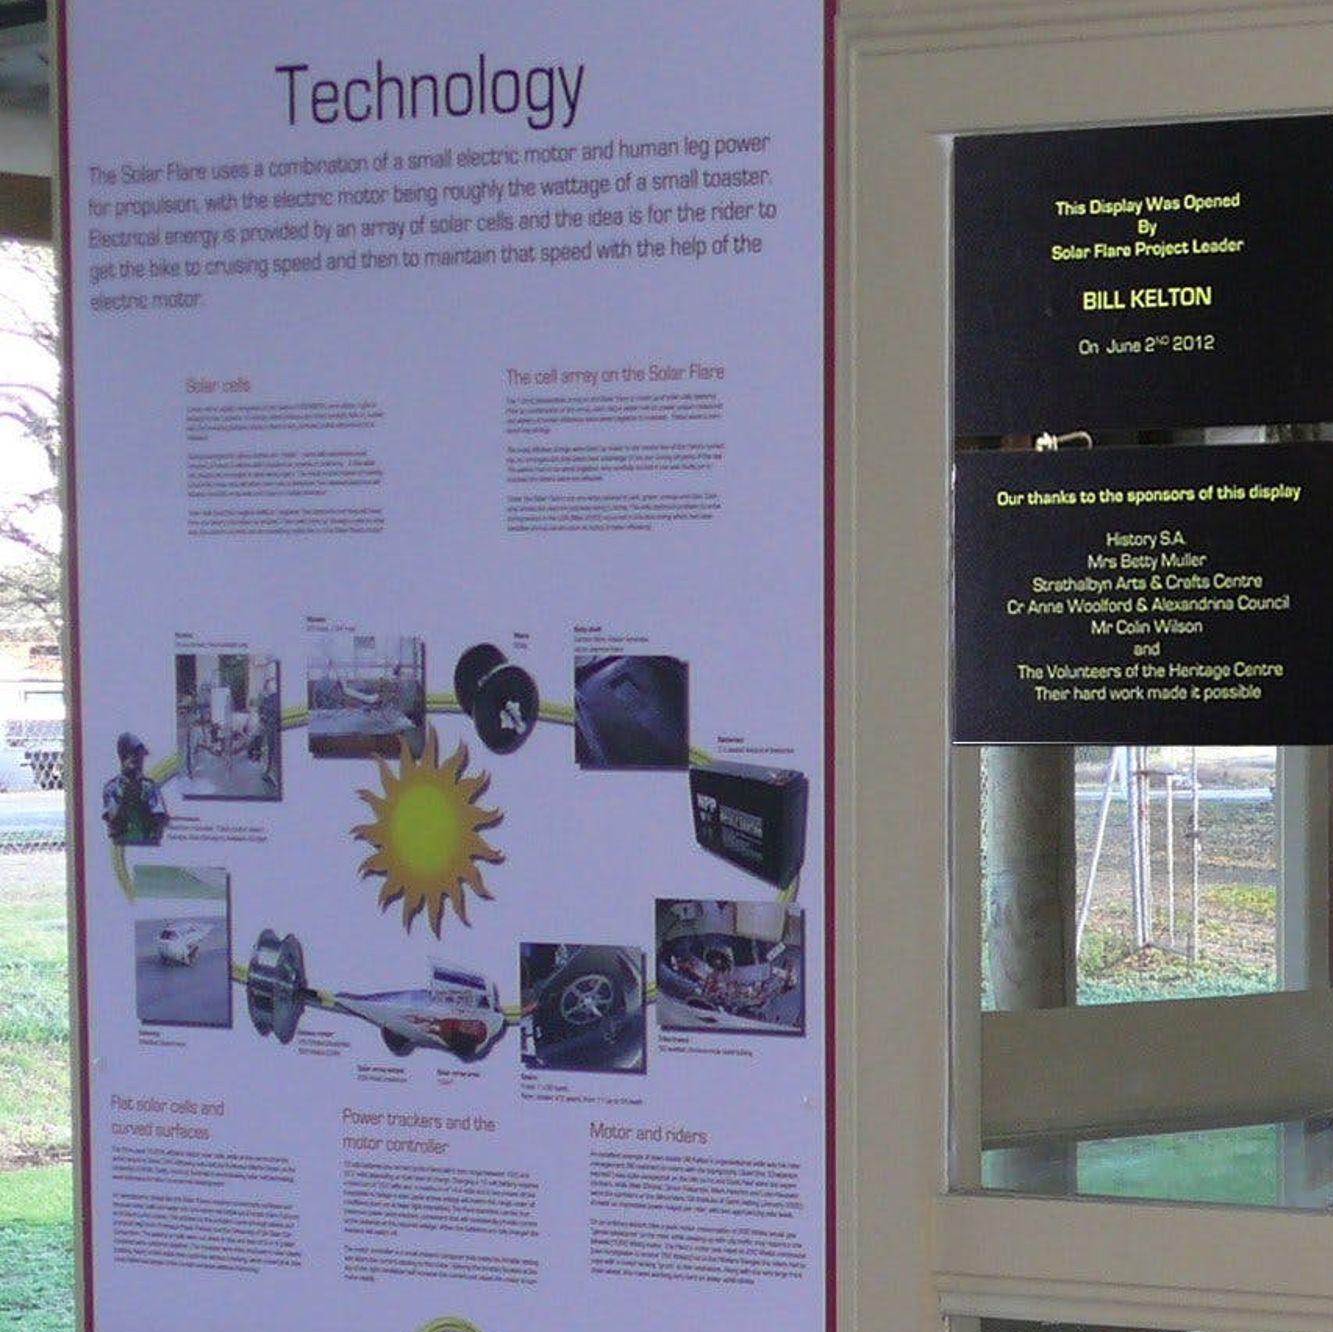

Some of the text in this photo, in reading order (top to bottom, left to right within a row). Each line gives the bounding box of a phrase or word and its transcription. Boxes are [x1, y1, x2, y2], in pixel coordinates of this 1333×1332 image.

[275, 53, 586, 131] Technology
[90, 135, 770, 185] The Solar Flare uses combination of small electric motor and human leg power
[338, 168, 699, 207] motor being roughly the wattage of small
[1055, 191, 1241, 217] This Display Was Opened
[240, 200, 777, 245] provided array of solar cells and the idea for the rider to
[1138, 218, 1158, 237] By
[272, 233, 762, 278] speed and then to maintain that speed with the help of the
[1051, 237, 1245, 261] Solar Flare Project Leader
[1083, 285, 1213, 311] BILL KELTON
[1078, 338, 1100, 355] On
[1106, 338, 1142, 354] June
[1172, 333, 1216, 352] 2012
[506, 362, 726, 387] The cell array on the Solar Flare
[996, 483, 1302, 507] Our thanks to the sponsors of this display
[1106, 531, 1157, 549] History
[1088, 552, 1207, 572] Mrs Betty Muller
[1032, 572, 1263, 596] Strathalbyn Arts & Crafts Centre
[1007, 594, 1290, 615] Cr Anne Woolford & Alexandrina Council
[1091, 617, 1203, 635] Mr Colin Wilson
[1132, 641, 1161, 657] and
[1016, 661, 1284, 682] The Volunteers of the Heritage Centre
[1034, 685, 1071, 701] Their
[1073, 685, 1106, 701] hard
[1109, 685, 1145, 701] work
[1147, 684, 1188, 700] made
[1203, 684, 1262, 702] possible
[342, 1107, 496, 1133] Power trackers and the
[343, 1135, 449, 1155] motor controller
[590, 1121, 709, 1145] Motor and riders
